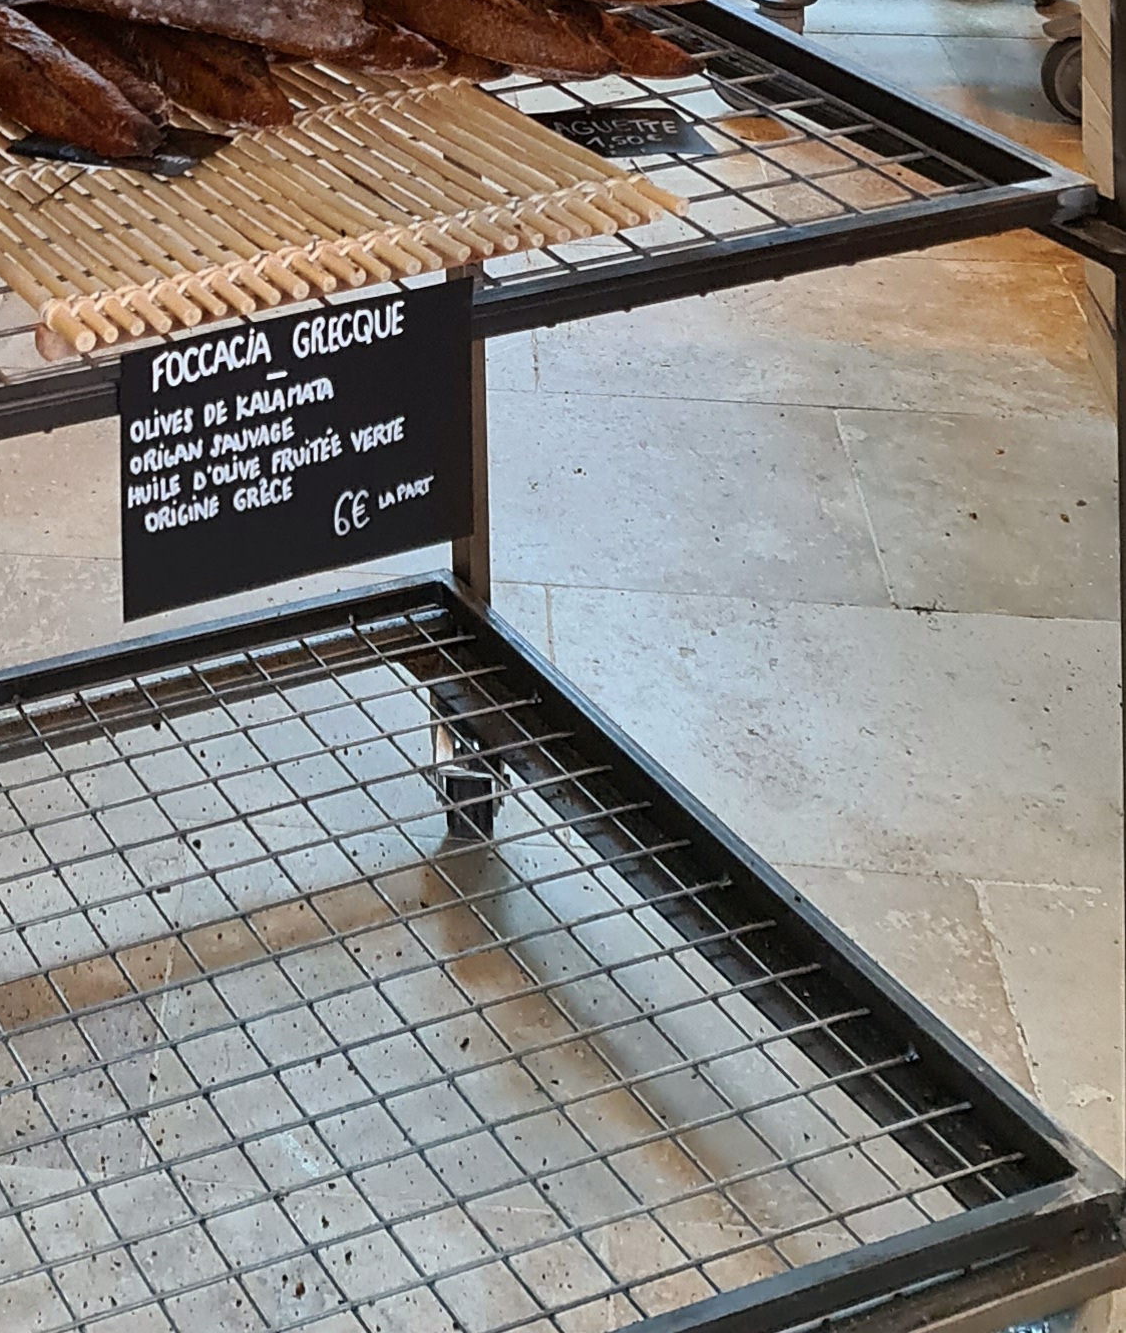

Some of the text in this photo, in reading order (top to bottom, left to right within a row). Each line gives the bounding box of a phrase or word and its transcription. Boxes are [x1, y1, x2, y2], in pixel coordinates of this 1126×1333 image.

[151, 300, 406, 393] FOCCACIA GRECQUE
[129, 376, 335, 445] OLIVES DE KALAMATA
[209, 416, 296, 458] SAUVAGE
[127, 473, 181, 509] HUILE
[350, 416, 406, 453] VERTE
[333, 474, 436, 537] 6€ LA PART
